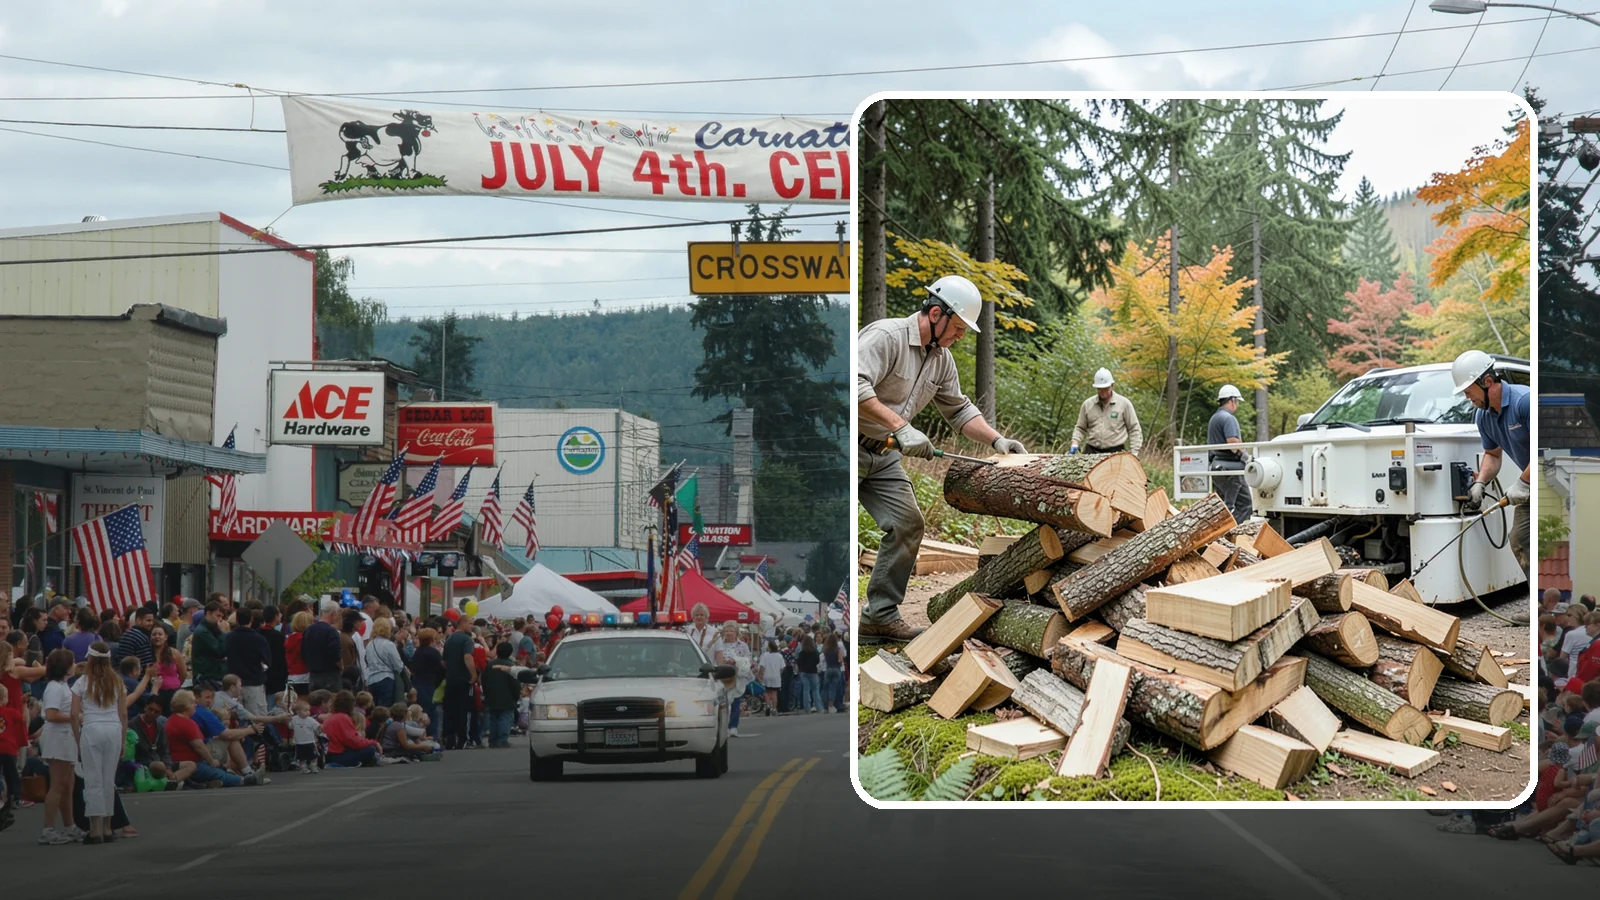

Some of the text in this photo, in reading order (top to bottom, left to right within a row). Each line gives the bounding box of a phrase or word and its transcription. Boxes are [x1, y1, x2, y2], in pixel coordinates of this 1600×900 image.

[481, 141, 605, 192] JULY
[632, 150, 746, 197] 4th.
[697, 254, 850, 279] CROSSWA
[283, 380, 373, 420] ACE
[405, 409, 452, 421] CEDAR
[284, 421, 371, 436] Hardware
[416, 428, 477, 447] Coca-Cola
[83, 485, 155, 495] St. Vincent de Paul
[688, 526, 741, 535] CRNATION
[699, 535, 730, 543] GLASS
